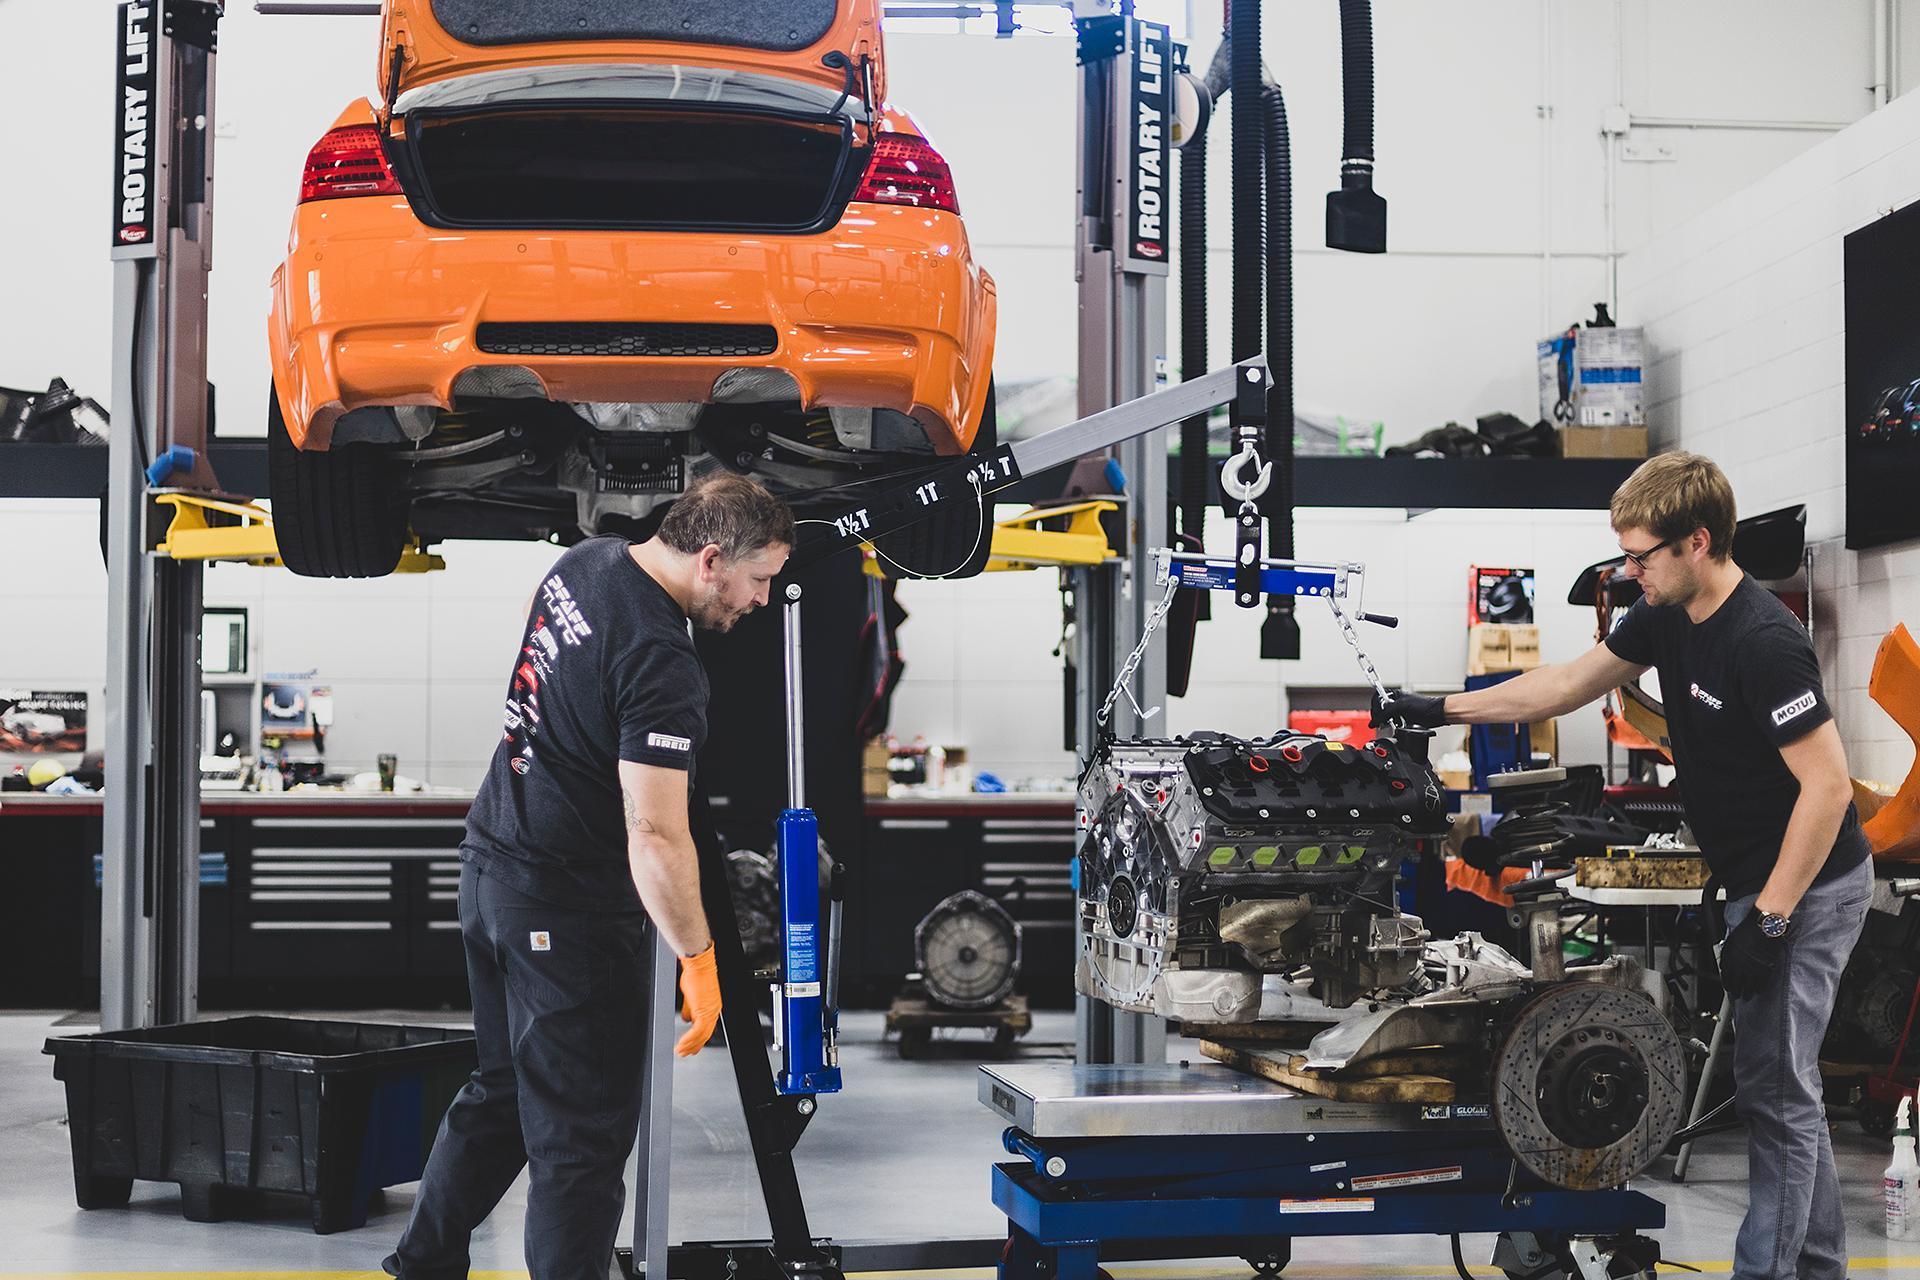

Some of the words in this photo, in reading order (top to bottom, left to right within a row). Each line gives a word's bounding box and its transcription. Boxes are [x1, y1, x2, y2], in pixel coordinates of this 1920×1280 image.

[126, 2, 150, 76] LIFT
[1139, 21, 1163, 95] LIFT
[122, 85, 148, 224] ROTARY
[1138, 101, 1162, 240] ROTARY
[915, 481, 939, 506] 1T
[1777, 697, 1815, 722] MOTUL
